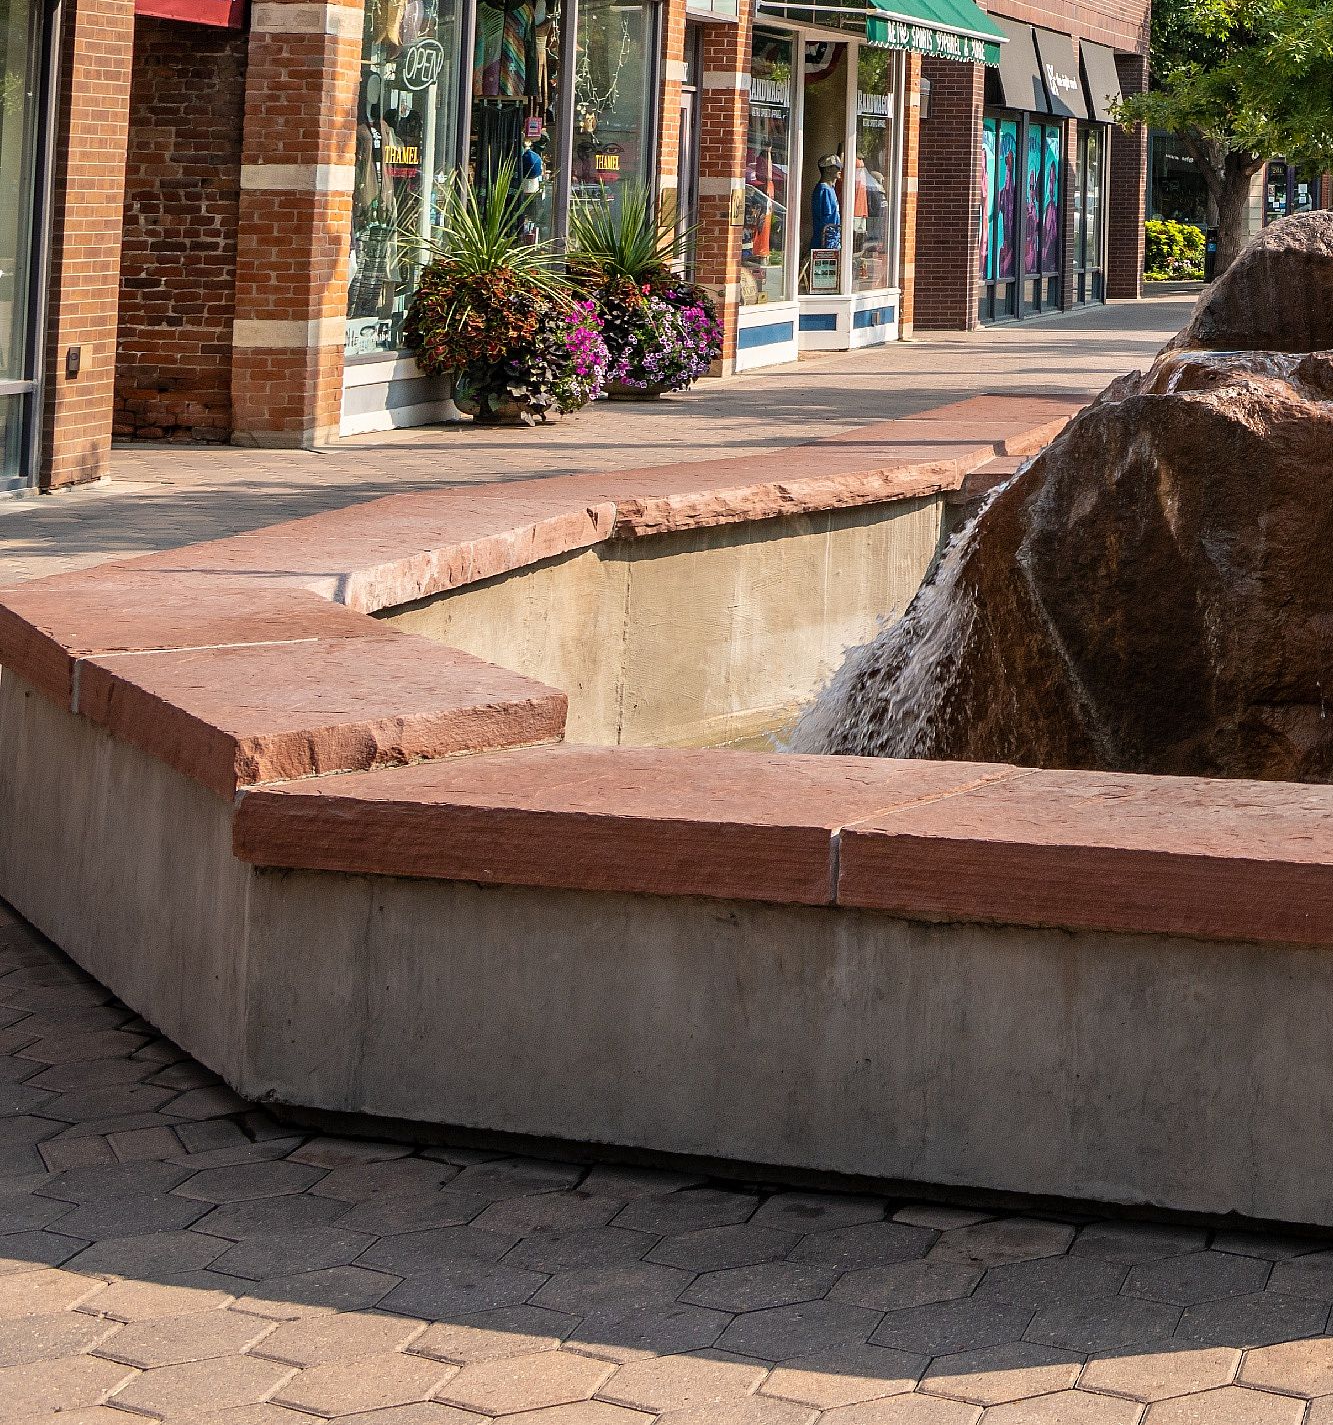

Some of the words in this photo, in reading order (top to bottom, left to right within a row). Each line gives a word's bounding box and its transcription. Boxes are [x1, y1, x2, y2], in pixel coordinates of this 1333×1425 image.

[405, 47, 441, 82] OPEN
[384, 145, 419, 165] THAMEL
[596, 155, 620, 171] THAMEL
